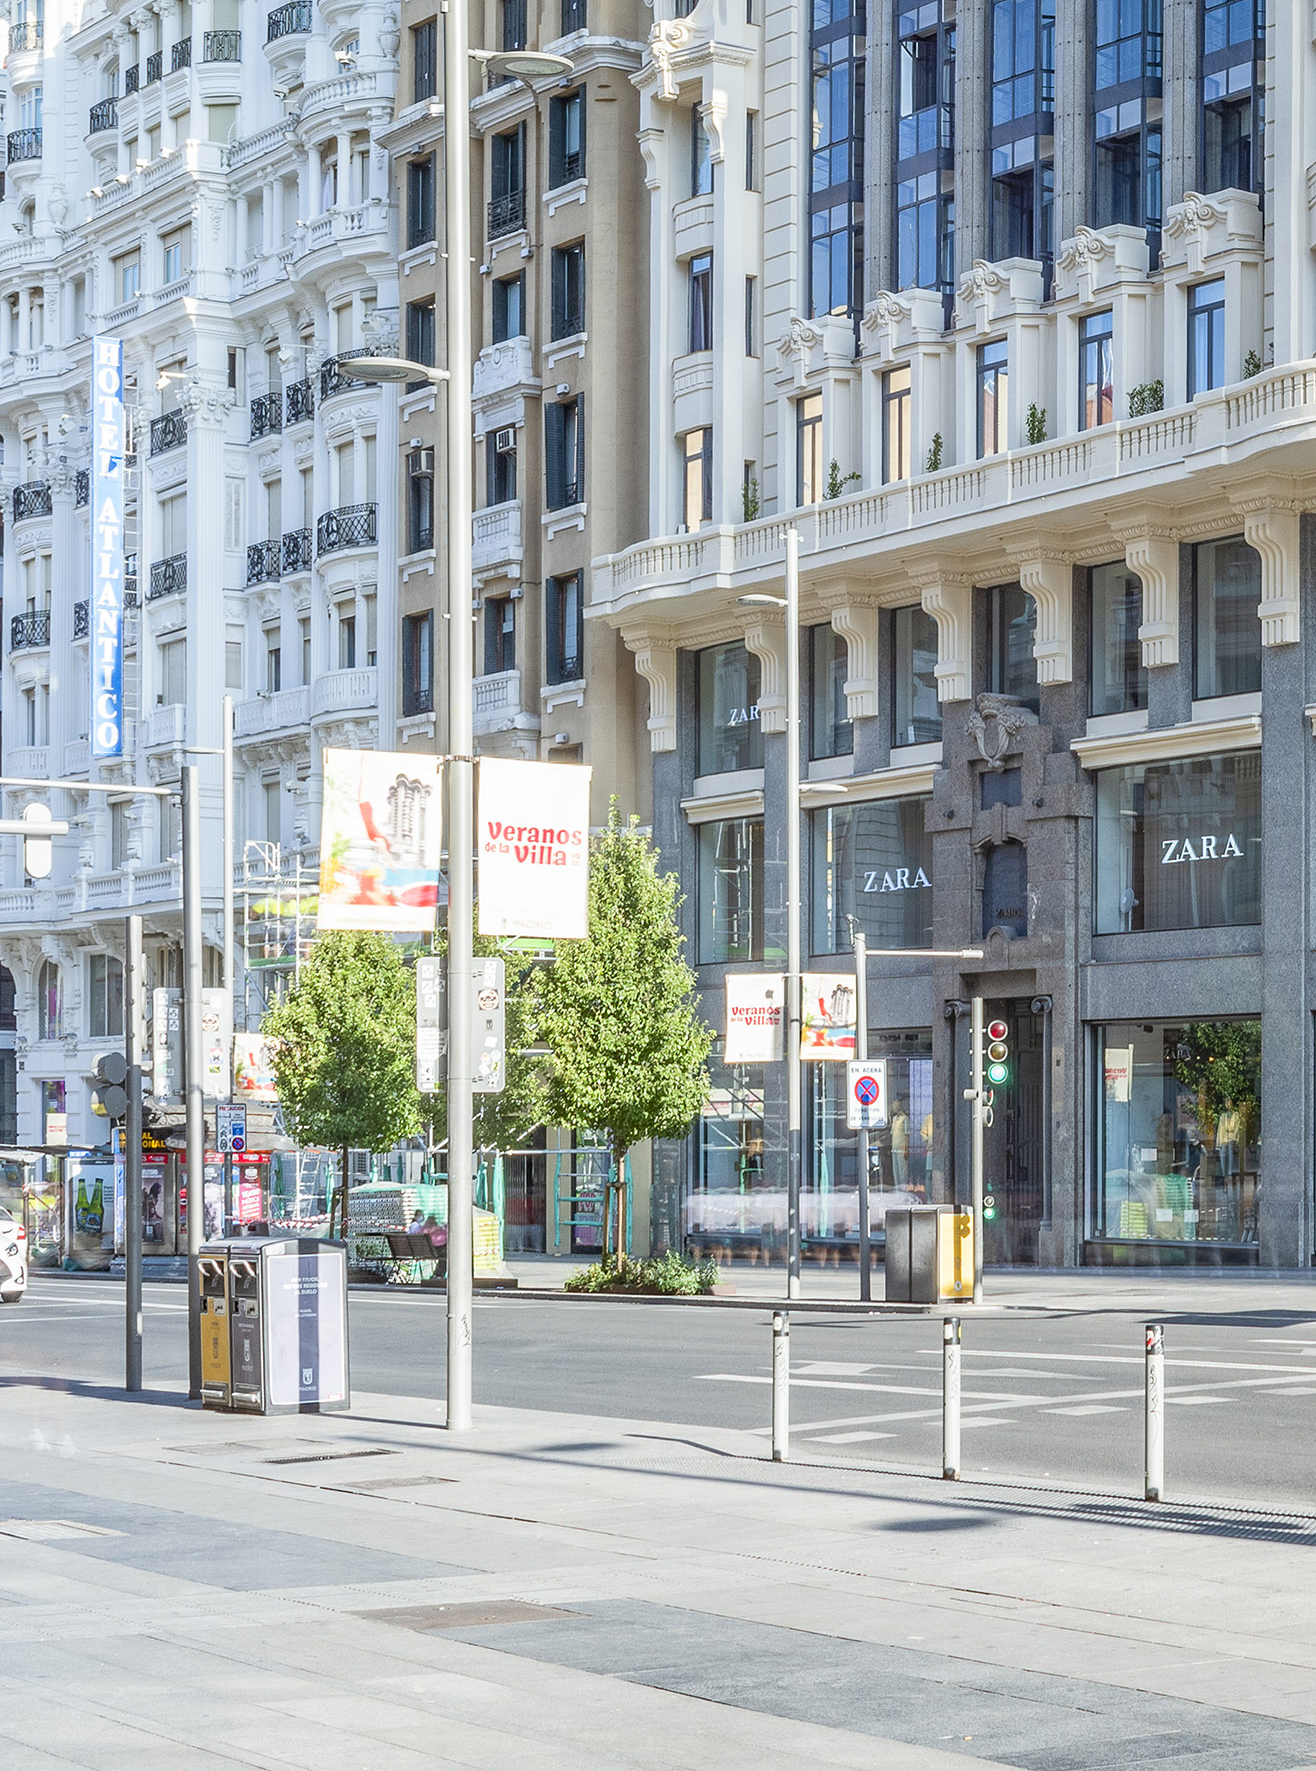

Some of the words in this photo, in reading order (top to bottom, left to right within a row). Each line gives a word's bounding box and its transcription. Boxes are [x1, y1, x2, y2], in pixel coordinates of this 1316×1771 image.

[97, 342, 121, 478] HOTEL
[97, 497, 120, 748] ATLANTICO
[729, 704, 760, 724] ZAR
[487, 821, 582, 846] Veranos
[485, 842, 497, 853] de
[514, 845, 567, 866] Villa
[1161, 833, 1245, 864] ZARA
[863, 867, 932, 893] ZARA
[731, 1006, 781, 1016] Veranos
[745, 1015, 775, 1026] Villa
